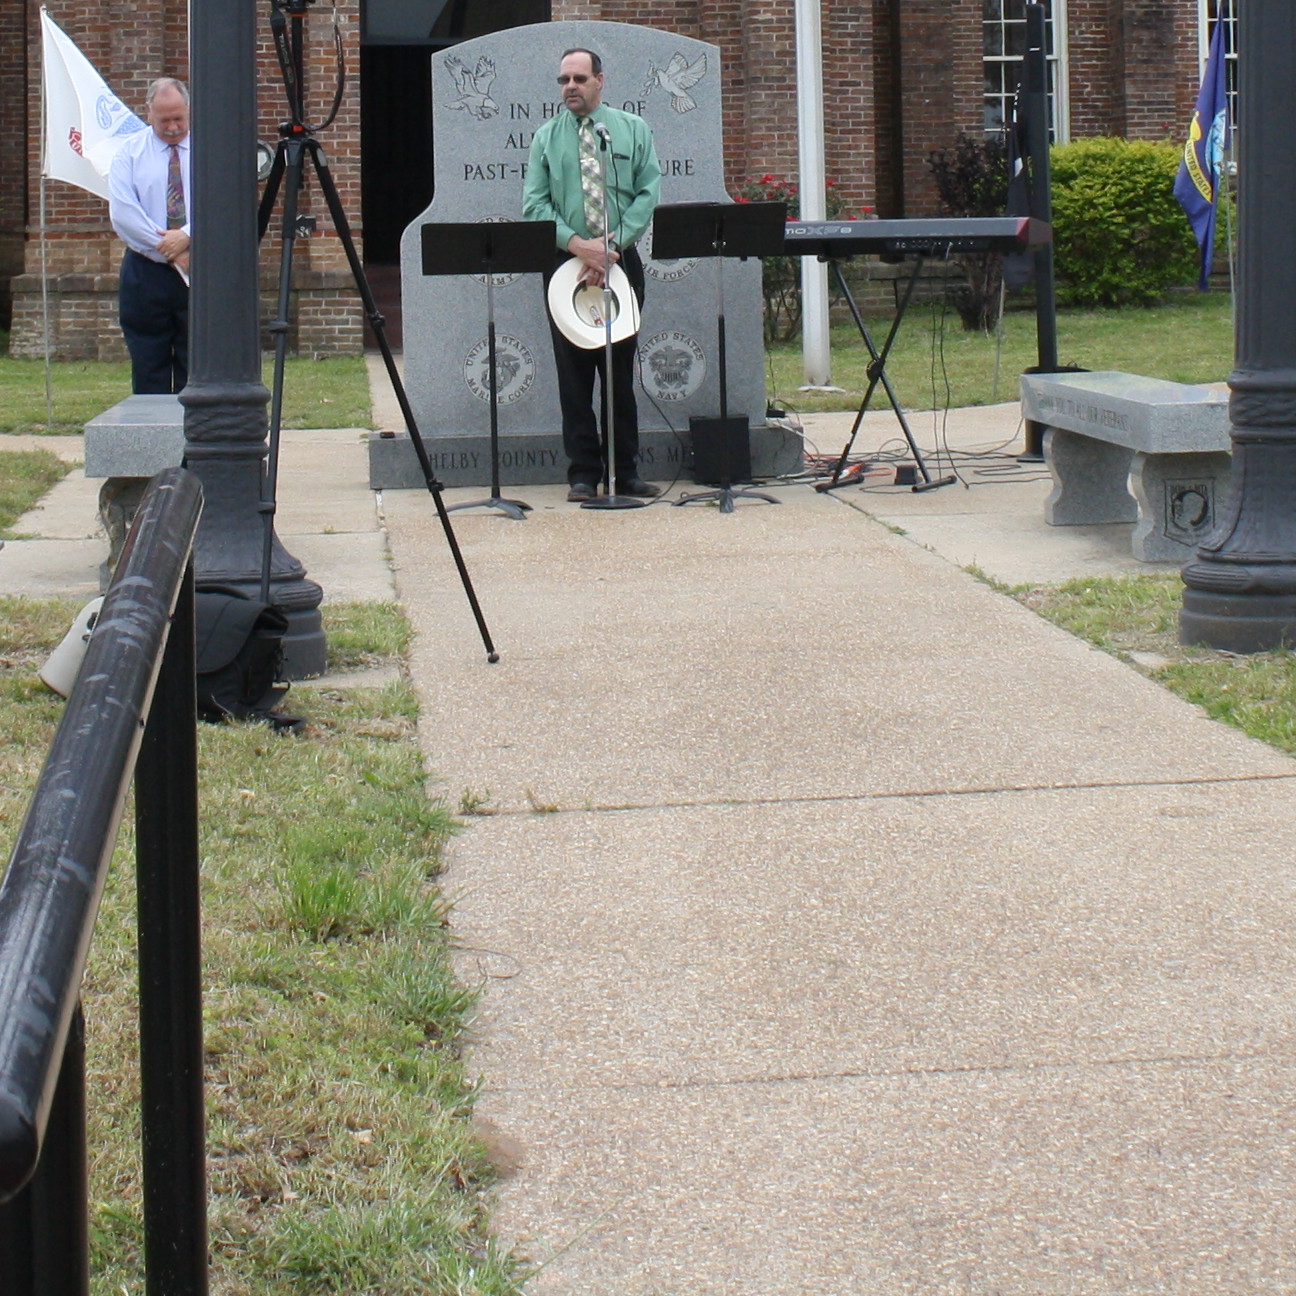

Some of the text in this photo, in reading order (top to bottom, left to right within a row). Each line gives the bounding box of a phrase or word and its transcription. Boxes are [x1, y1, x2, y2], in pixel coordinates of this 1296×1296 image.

[510, 103, 530, 120] IN
[663, 259, 696, 280] FORCE
[502, 336, 533, 364] STATES
[639, 332, 704, 363] UNITED STATES
[467, 374, 533, 404] MARIE CORPS
[657, 390, 687, 400] NAVY
[428, 449, 558, 470] HELBY OUNTY
